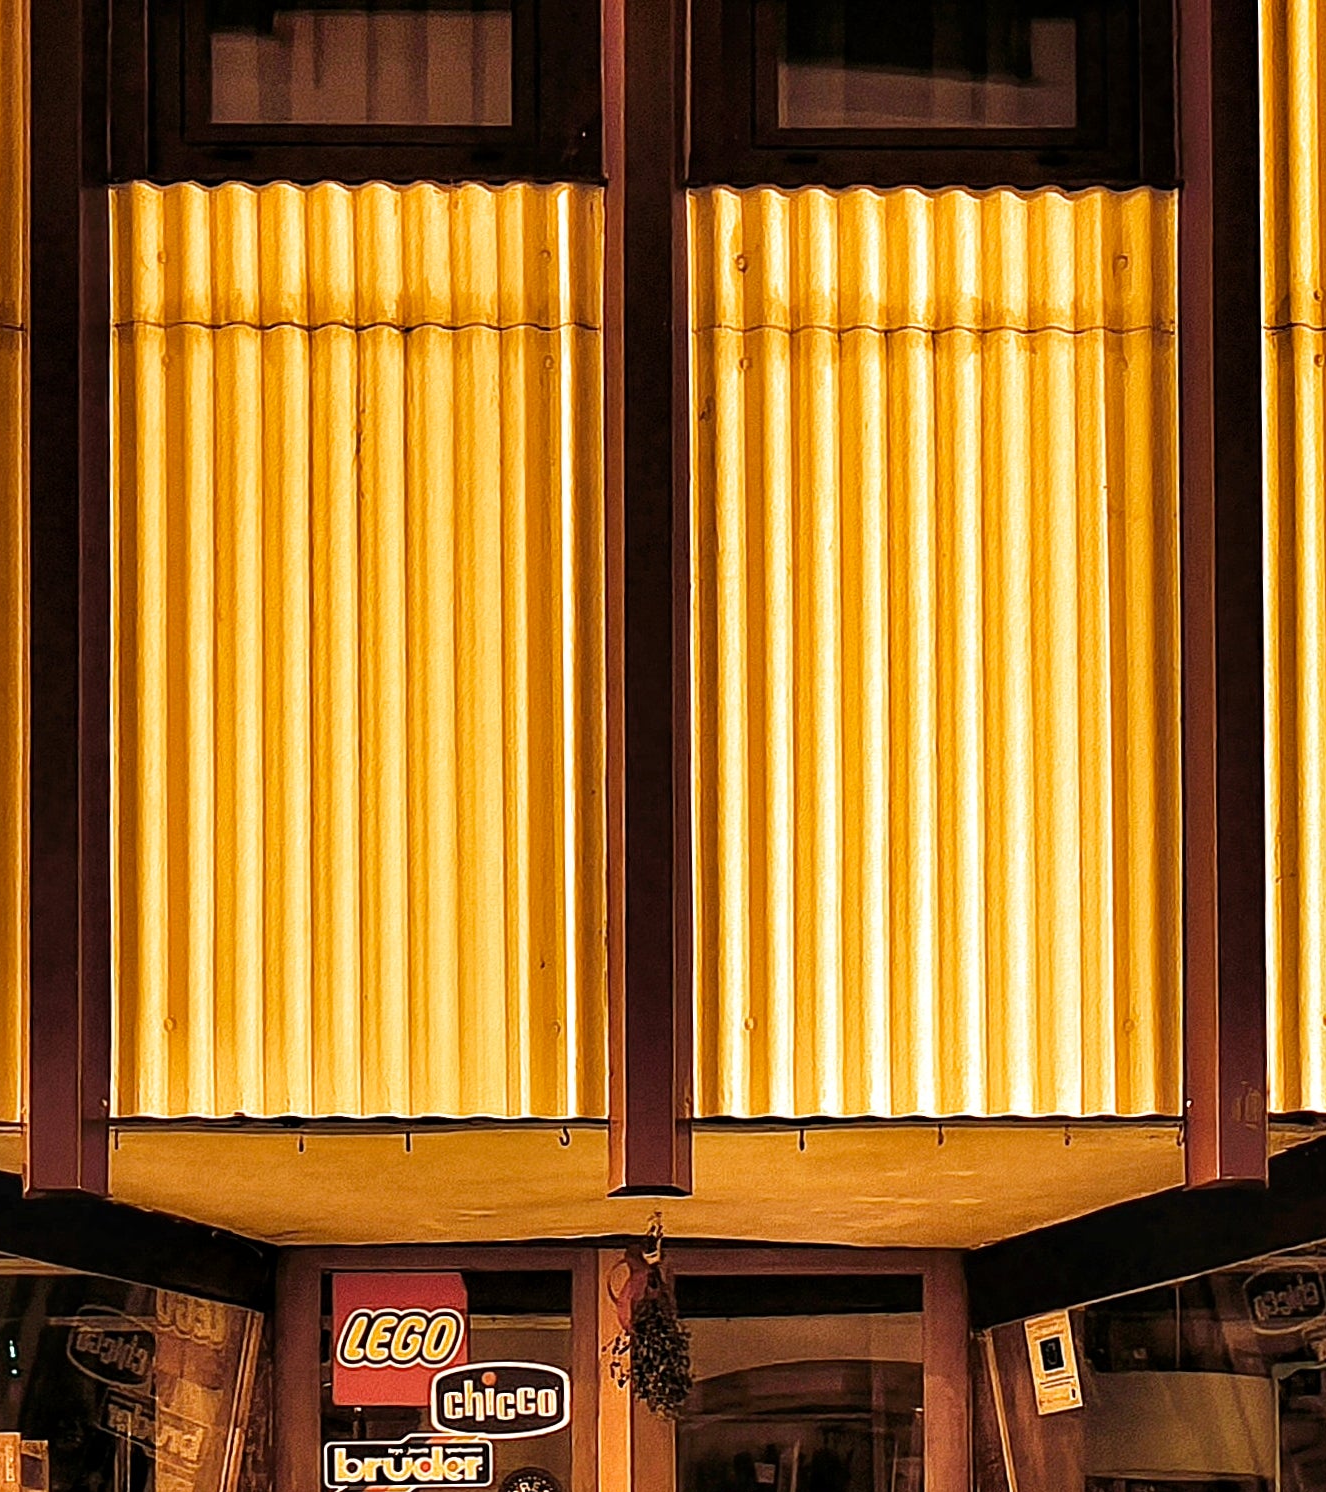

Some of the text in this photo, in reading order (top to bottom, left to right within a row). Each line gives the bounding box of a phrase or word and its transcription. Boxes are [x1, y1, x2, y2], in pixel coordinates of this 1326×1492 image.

[340, 1311, 461, 1364] LEGO
[443, 1371, 558, 1422] chicco
[333, 1446, 483, 1482] bruder
